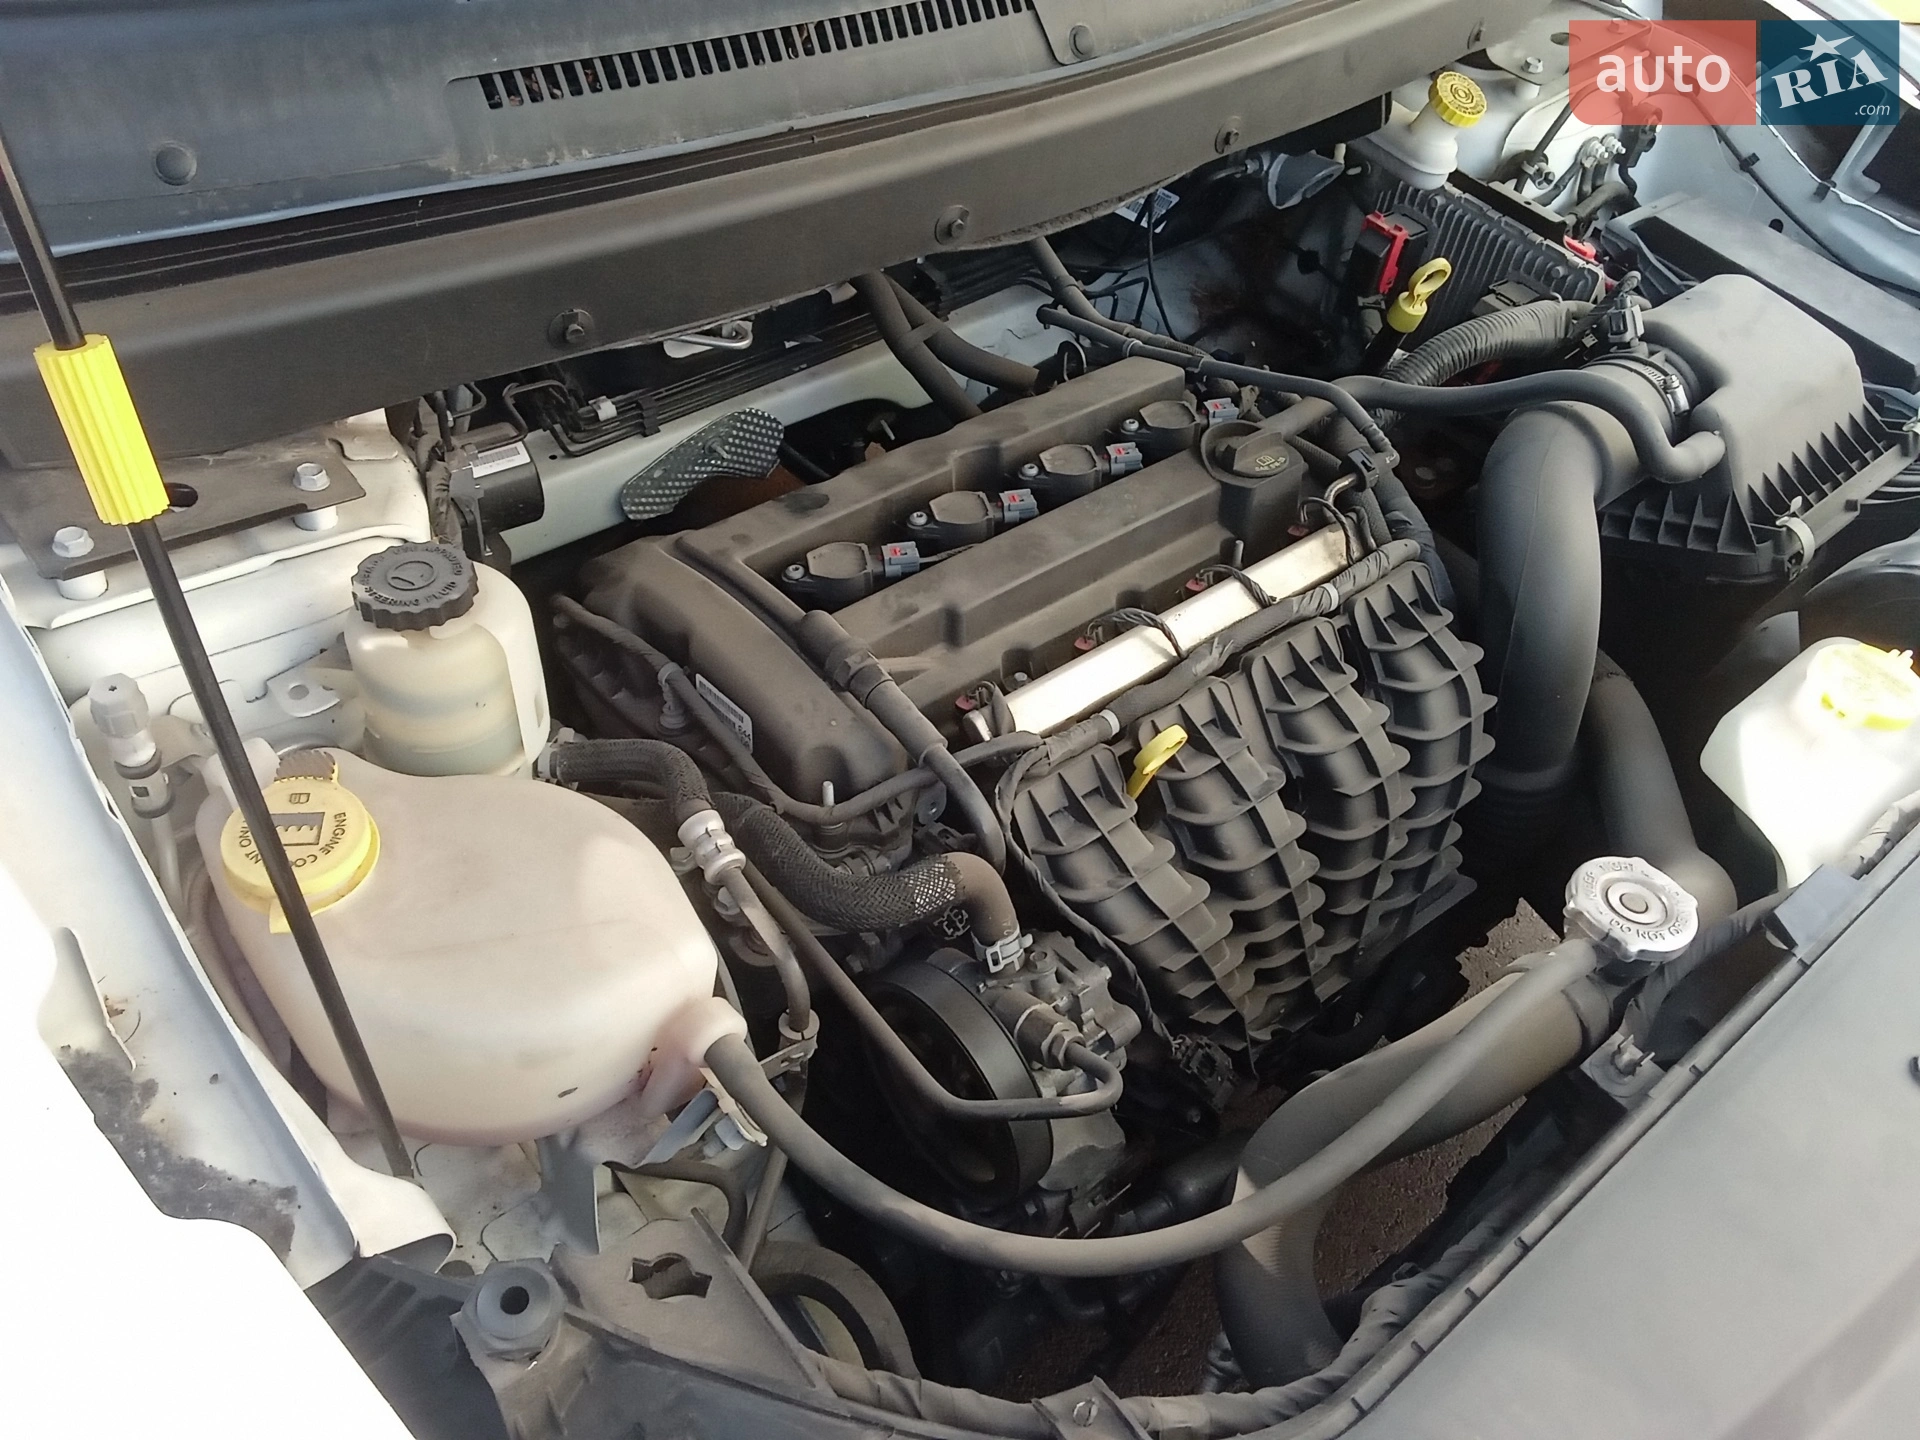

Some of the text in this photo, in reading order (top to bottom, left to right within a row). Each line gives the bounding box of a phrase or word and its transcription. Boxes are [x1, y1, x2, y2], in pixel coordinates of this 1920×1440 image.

[364, 586, 421, 607] STEERING
[425, 581, 457, 603] FLUID
[319, 812, 347, 856] ENGINE
[1609, 918, 1632, 934] DO
[1636, 929, 1666, 942] NOT
